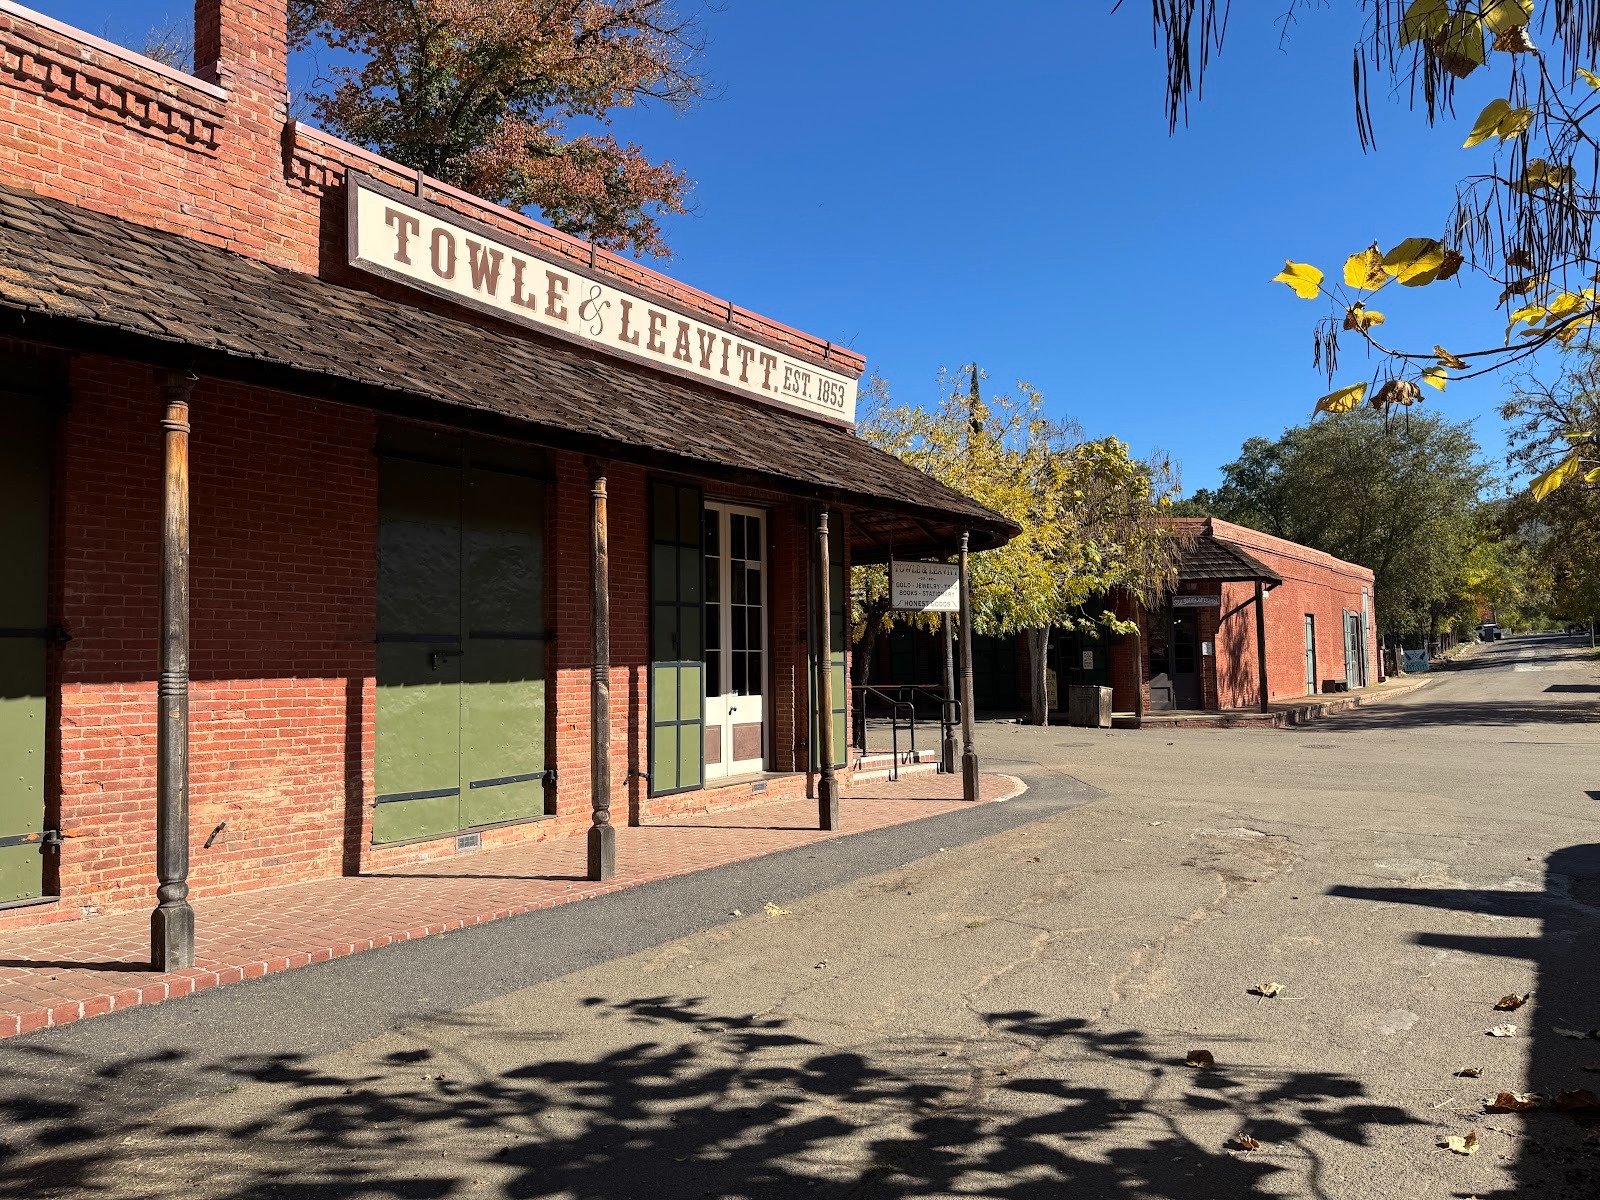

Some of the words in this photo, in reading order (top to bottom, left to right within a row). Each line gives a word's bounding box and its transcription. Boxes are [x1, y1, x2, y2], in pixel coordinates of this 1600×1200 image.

[385, 206, 569, 322] TOWLE
[578, 284, 611, 337] &
[783, 365, 812, 399] EST.
[817, 377, 845, 408] 1853
[894, 563, 920, 574] TOWLE
[921, 566, 928, 575] &
